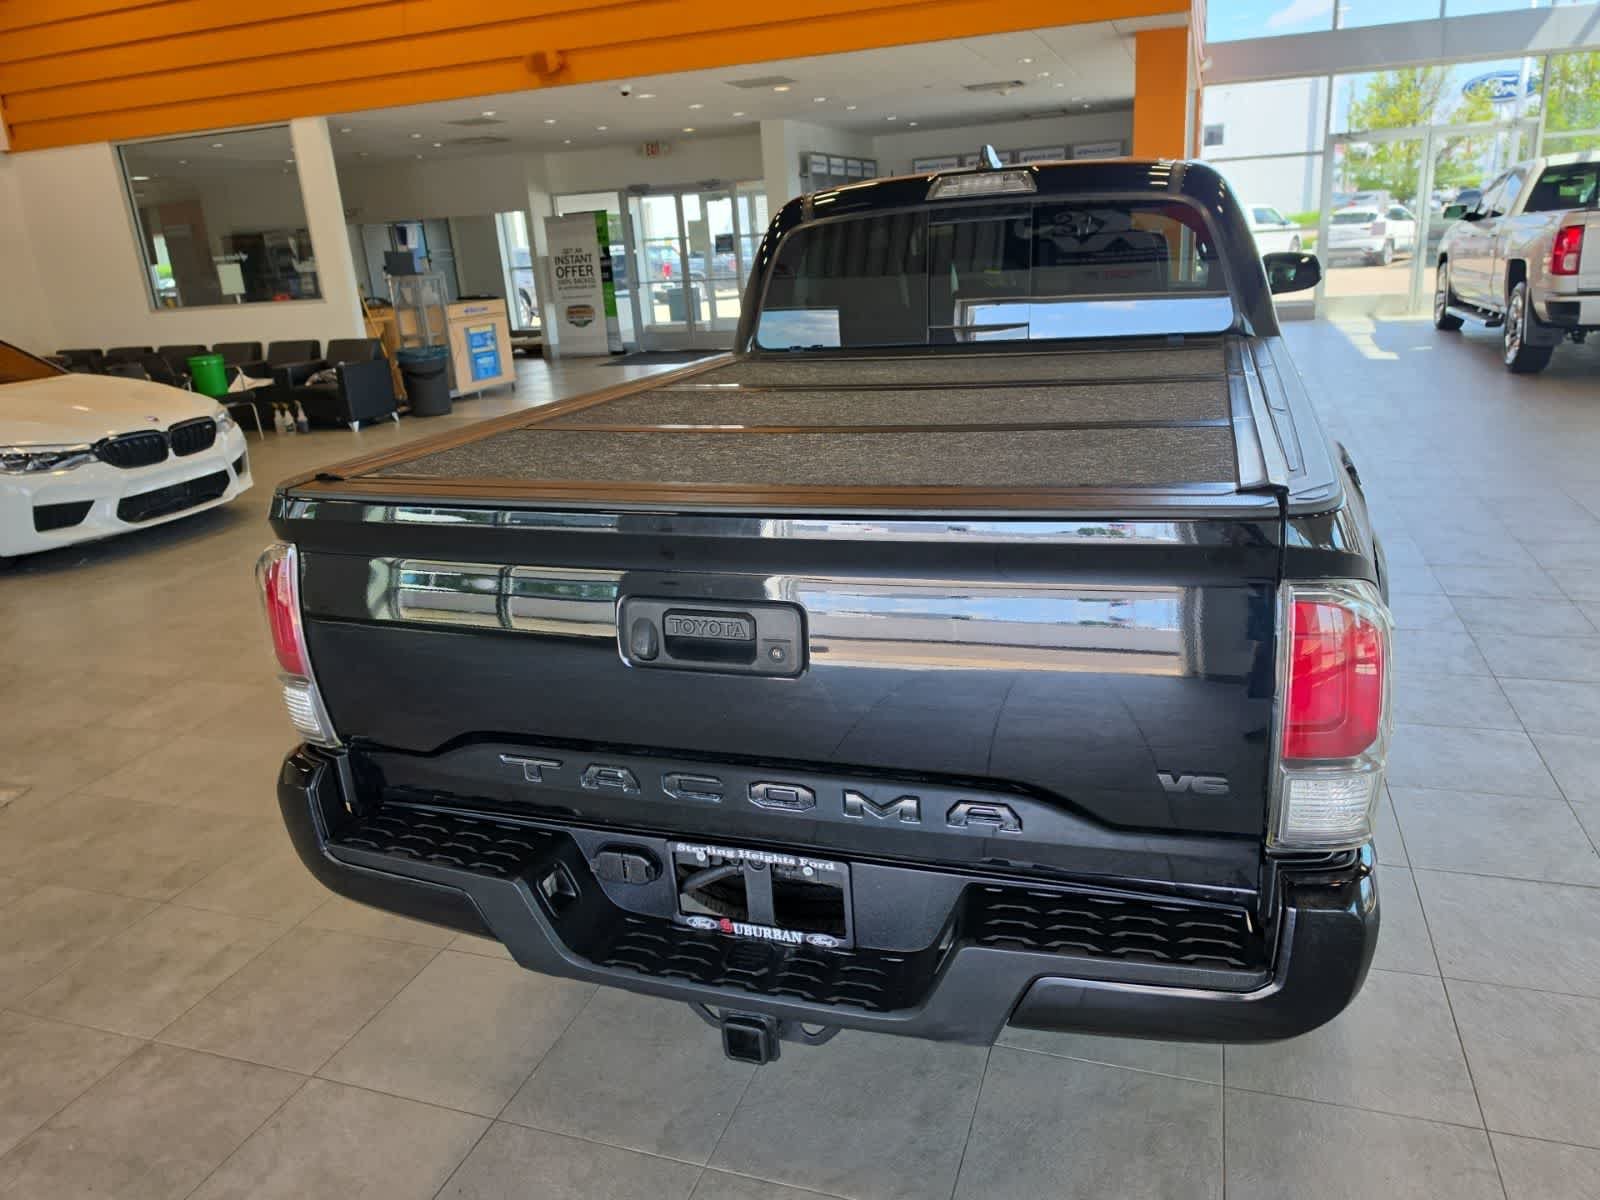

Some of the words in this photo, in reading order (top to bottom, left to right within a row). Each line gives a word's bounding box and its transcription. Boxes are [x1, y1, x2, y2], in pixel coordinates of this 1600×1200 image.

[554, 254, 592, 265] INSTANT
[555, 265, 594, 279] OFFER
[669, 617, 746, 639] TOYOTA
[499, 753, 1024, 833] TACOMA
[1156, 773, 1230, 795] V6
[676, 842, 736, 859] Sterling
[737, 849, 796, 866] Heights
[798, 857, 835, 871] Ford
[719, 918, 803, 944] SUBURBAN
